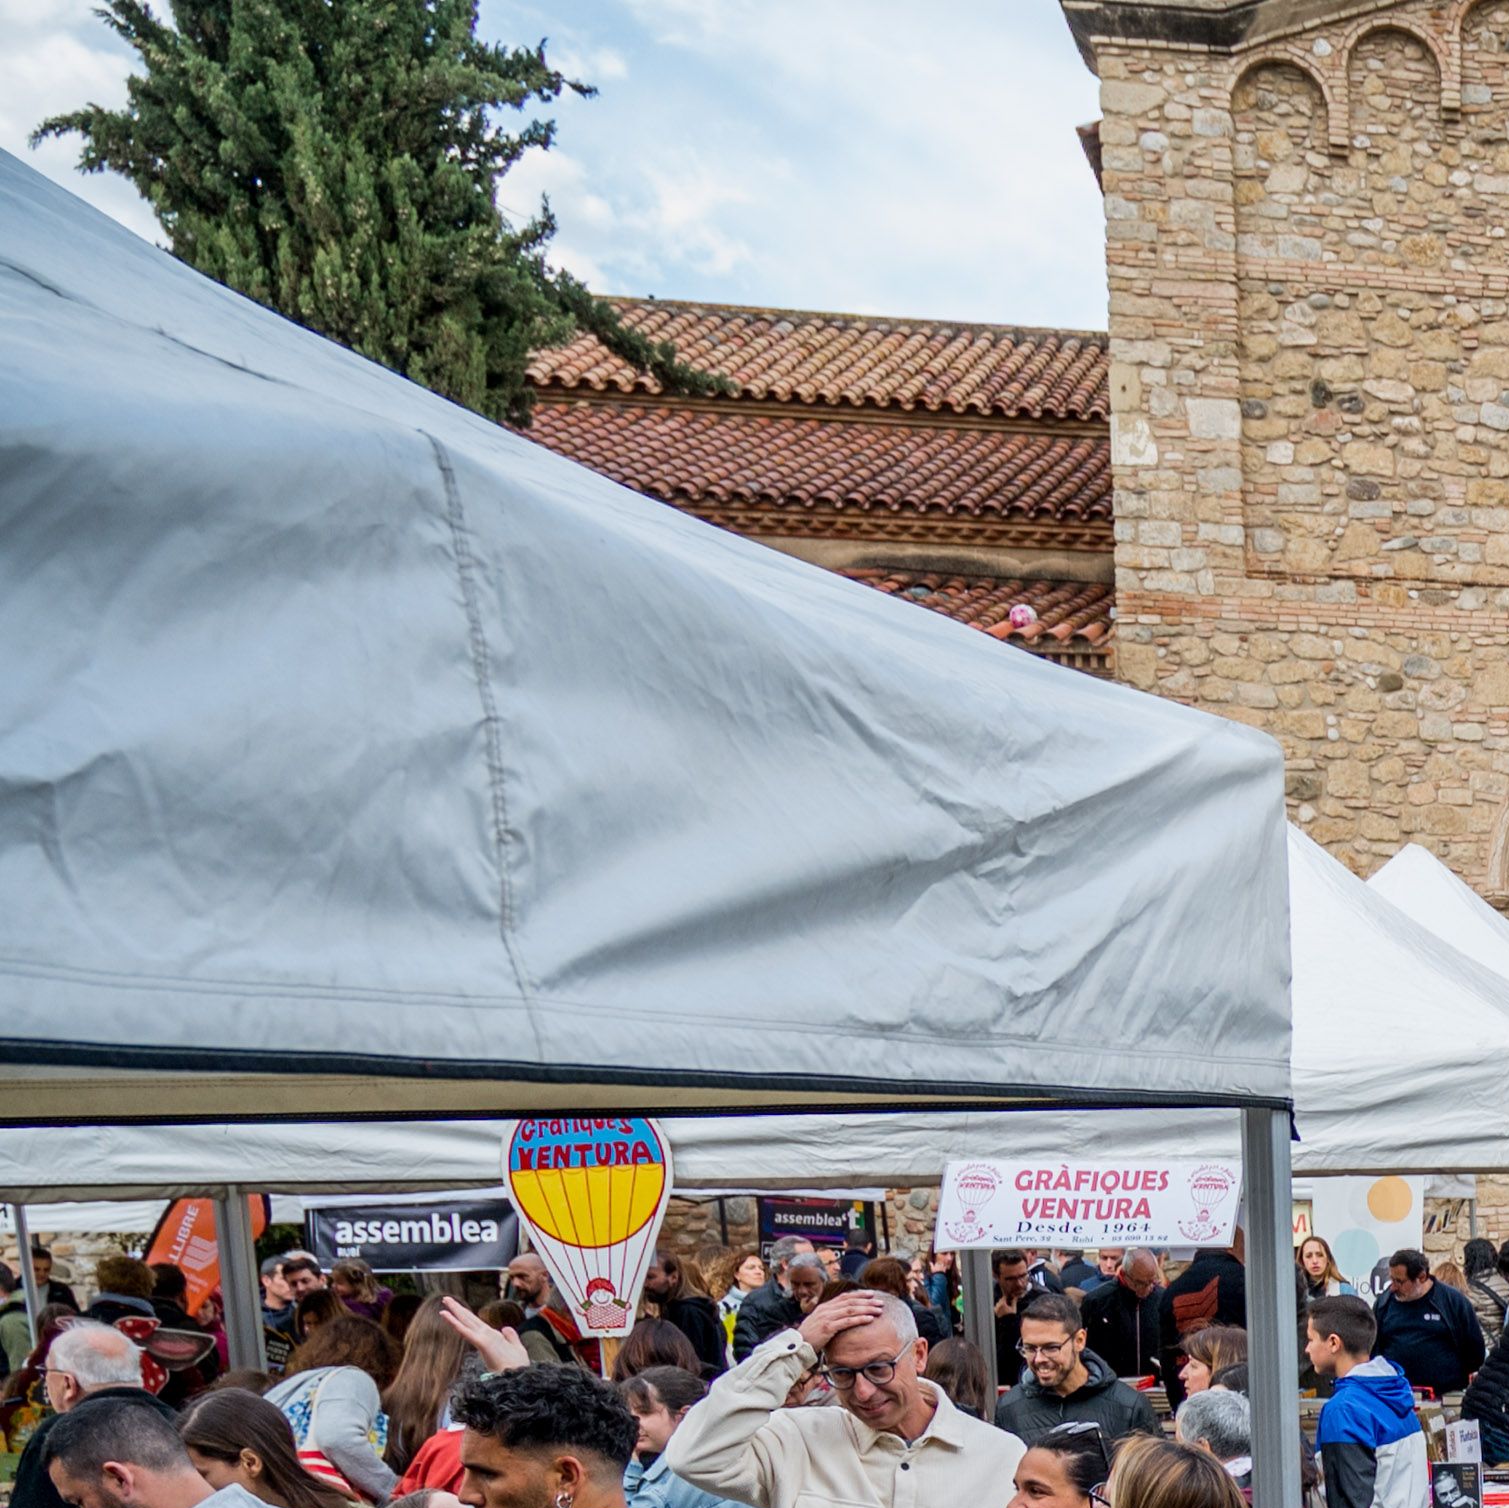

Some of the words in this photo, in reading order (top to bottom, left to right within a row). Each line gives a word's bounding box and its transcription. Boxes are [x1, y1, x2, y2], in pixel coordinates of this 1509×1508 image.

[518, 1140, 655, 1170] VENTURA
[1014, 1164, 1169, 1194] GRÀFIQUES
[1021, 1197, 1152, 1220] VENTURA
[334, 1212, 498, 1244] assemblea
[992, 1234, 1013, 1243] Sant
[1017, 1221, 1083, 1234] Desde
[1103, 1222, 1151, 1234] 1964
